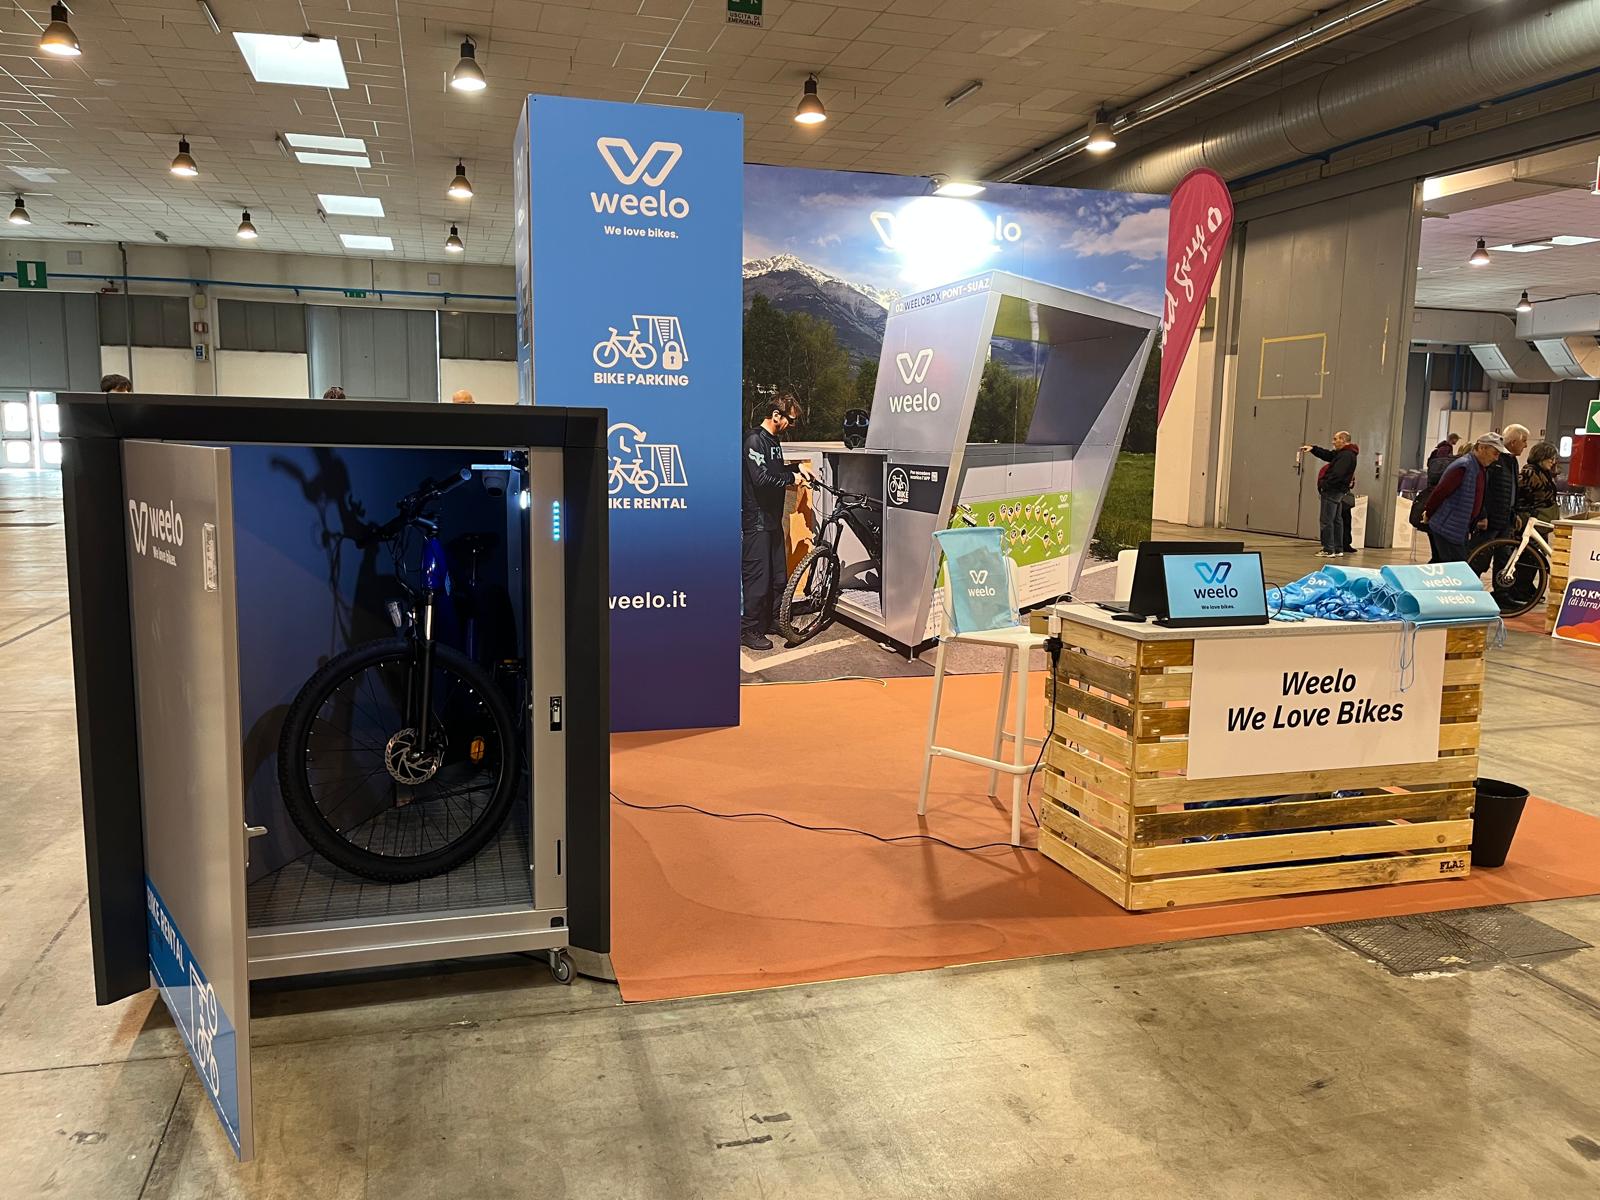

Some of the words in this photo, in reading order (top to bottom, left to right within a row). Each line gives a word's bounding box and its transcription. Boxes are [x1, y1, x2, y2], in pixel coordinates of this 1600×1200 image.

[728, 17, 760, 26] EMERGENZA
[590, 190, 690, 219] weelo
[604, 225, 623, 237] We
[624, 226, 646, 238] love
[648, 228, 679, 239] bikes.
[904, 292, 941, 311] WEELOBOX
[942, 278, 990, 299] PONT-SUAZ
[593, 372, 625, 386] BIKE
[627, 373, 689, 387] PARKING
[889, 391, 941, 413] weelo
[608, 498, 631, 509] IKE
[634, 498, 688, 509] RENTAL
[149, 500, 184, 547] weelo
[1422, 576, 1462, 588] weelo
[968, 586, 996, 598] weelo
[1194, 585, 1238, 599] weelo
[1436, 594, 1476, 604] weelo
[1572, 588, 1587, 598] 100
[1568, 597, 1578, 606] (di
[1282, 668, 1356, 696] Weelo
[1228, 706, 1266, 732] We
[1272, 704, 1330, 729] Love
[1336, 698, 1404, 725] Bikes
